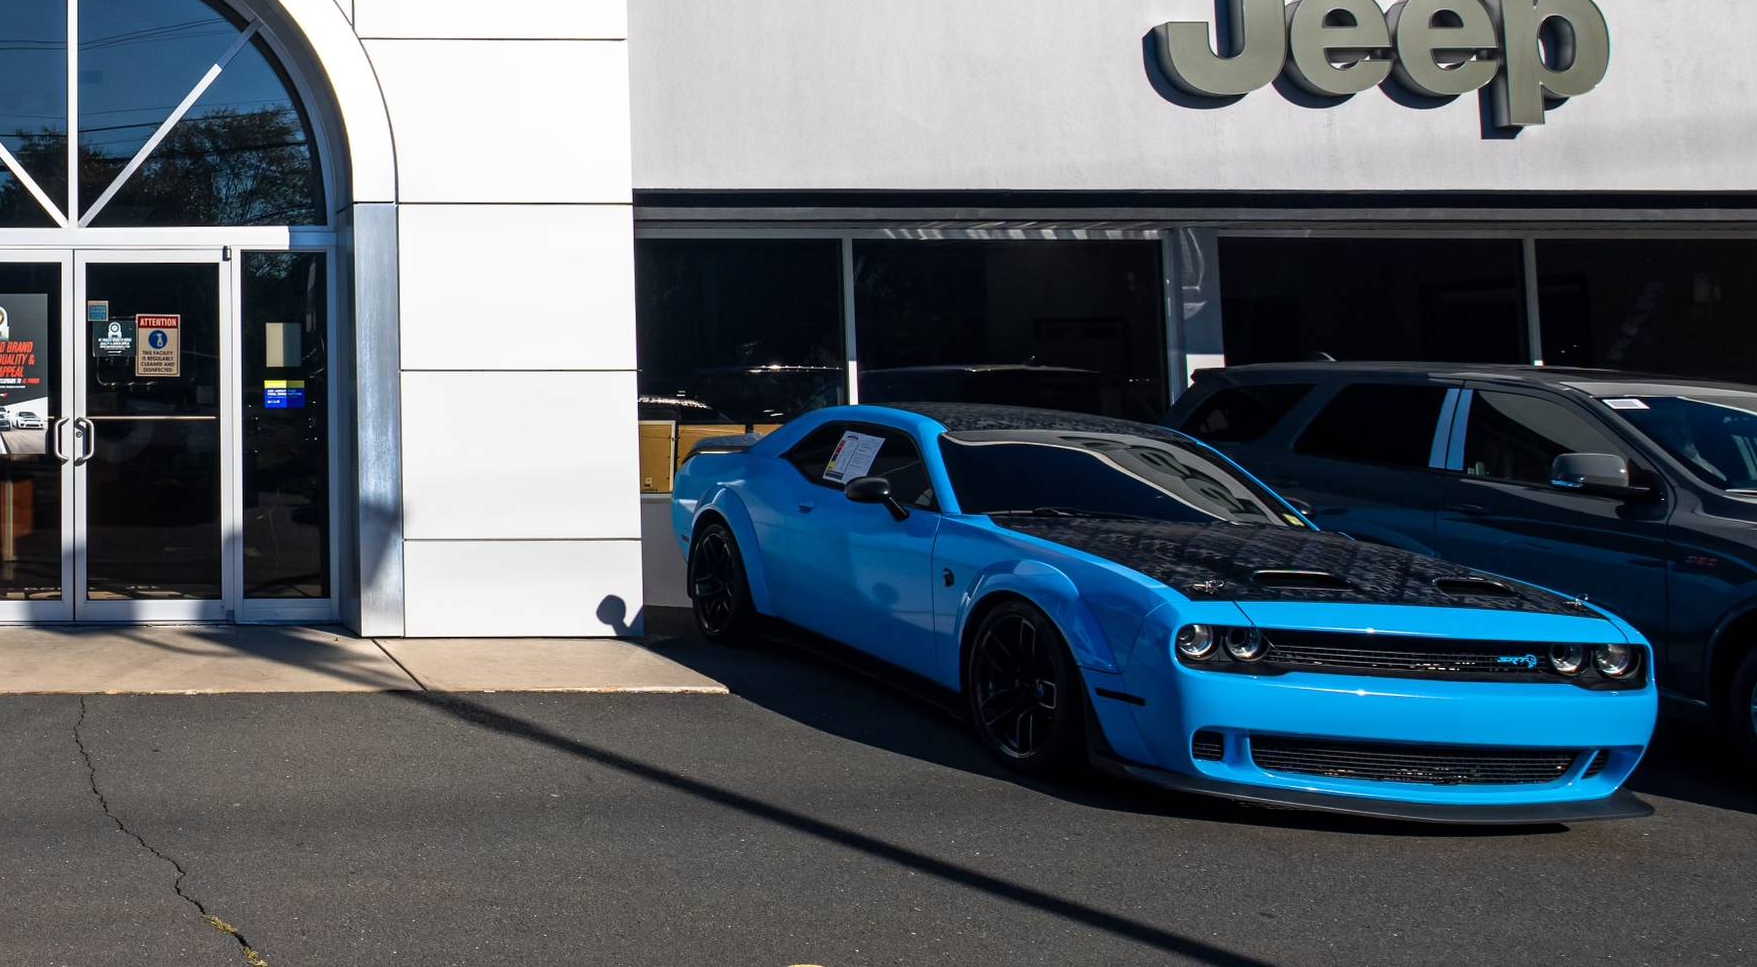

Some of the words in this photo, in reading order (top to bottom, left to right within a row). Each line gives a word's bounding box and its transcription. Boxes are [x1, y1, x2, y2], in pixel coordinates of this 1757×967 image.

[139, 318, 178, 327] ATTENTION
[6, 341, 34, 353] BRAND
[28, 354, 36, 366] &
